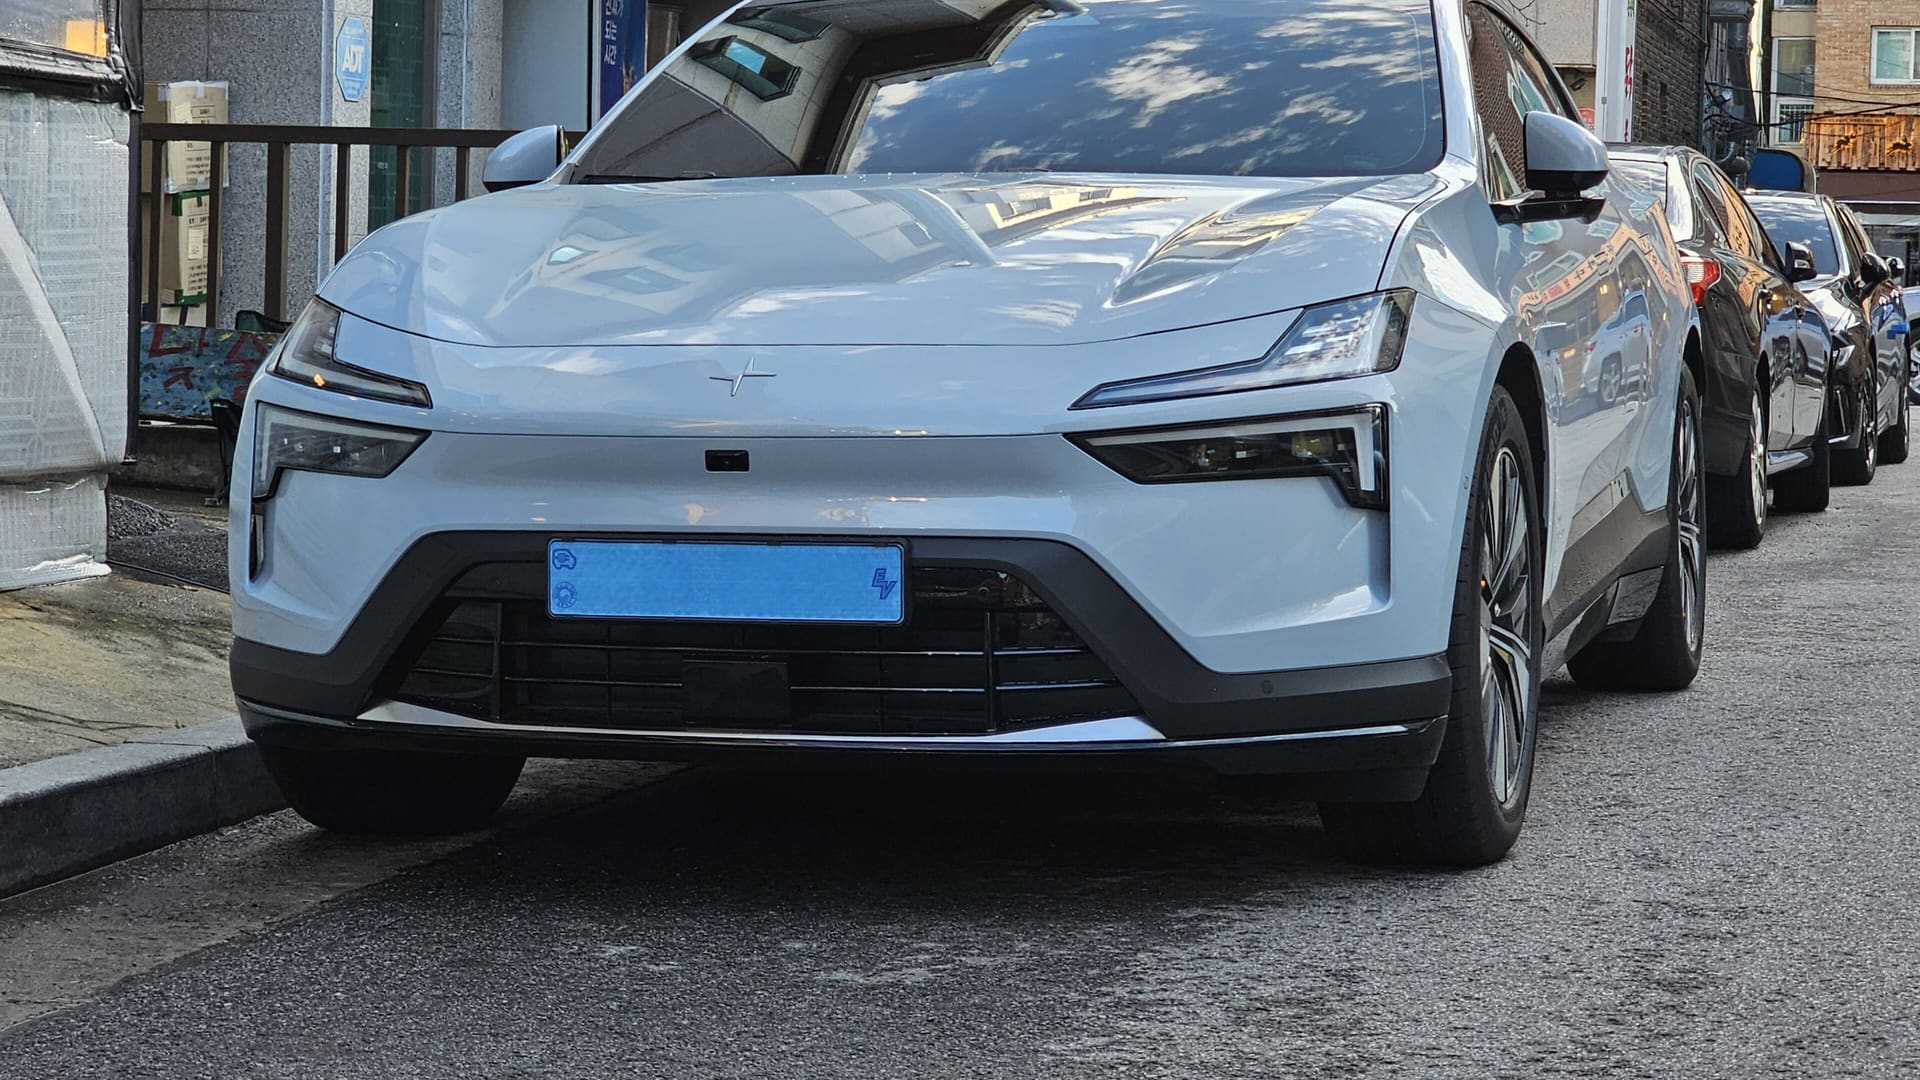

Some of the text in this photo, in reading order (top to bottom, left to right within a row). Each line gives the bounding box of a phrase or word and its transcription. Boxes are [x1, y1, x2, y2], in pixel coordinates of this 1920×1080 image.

[604, 20, 617, 40] 되는
[341, 45, 364, 73] ADT
[603, 44, 617, 65] 시간
[871, 568, 897, 600] EV
